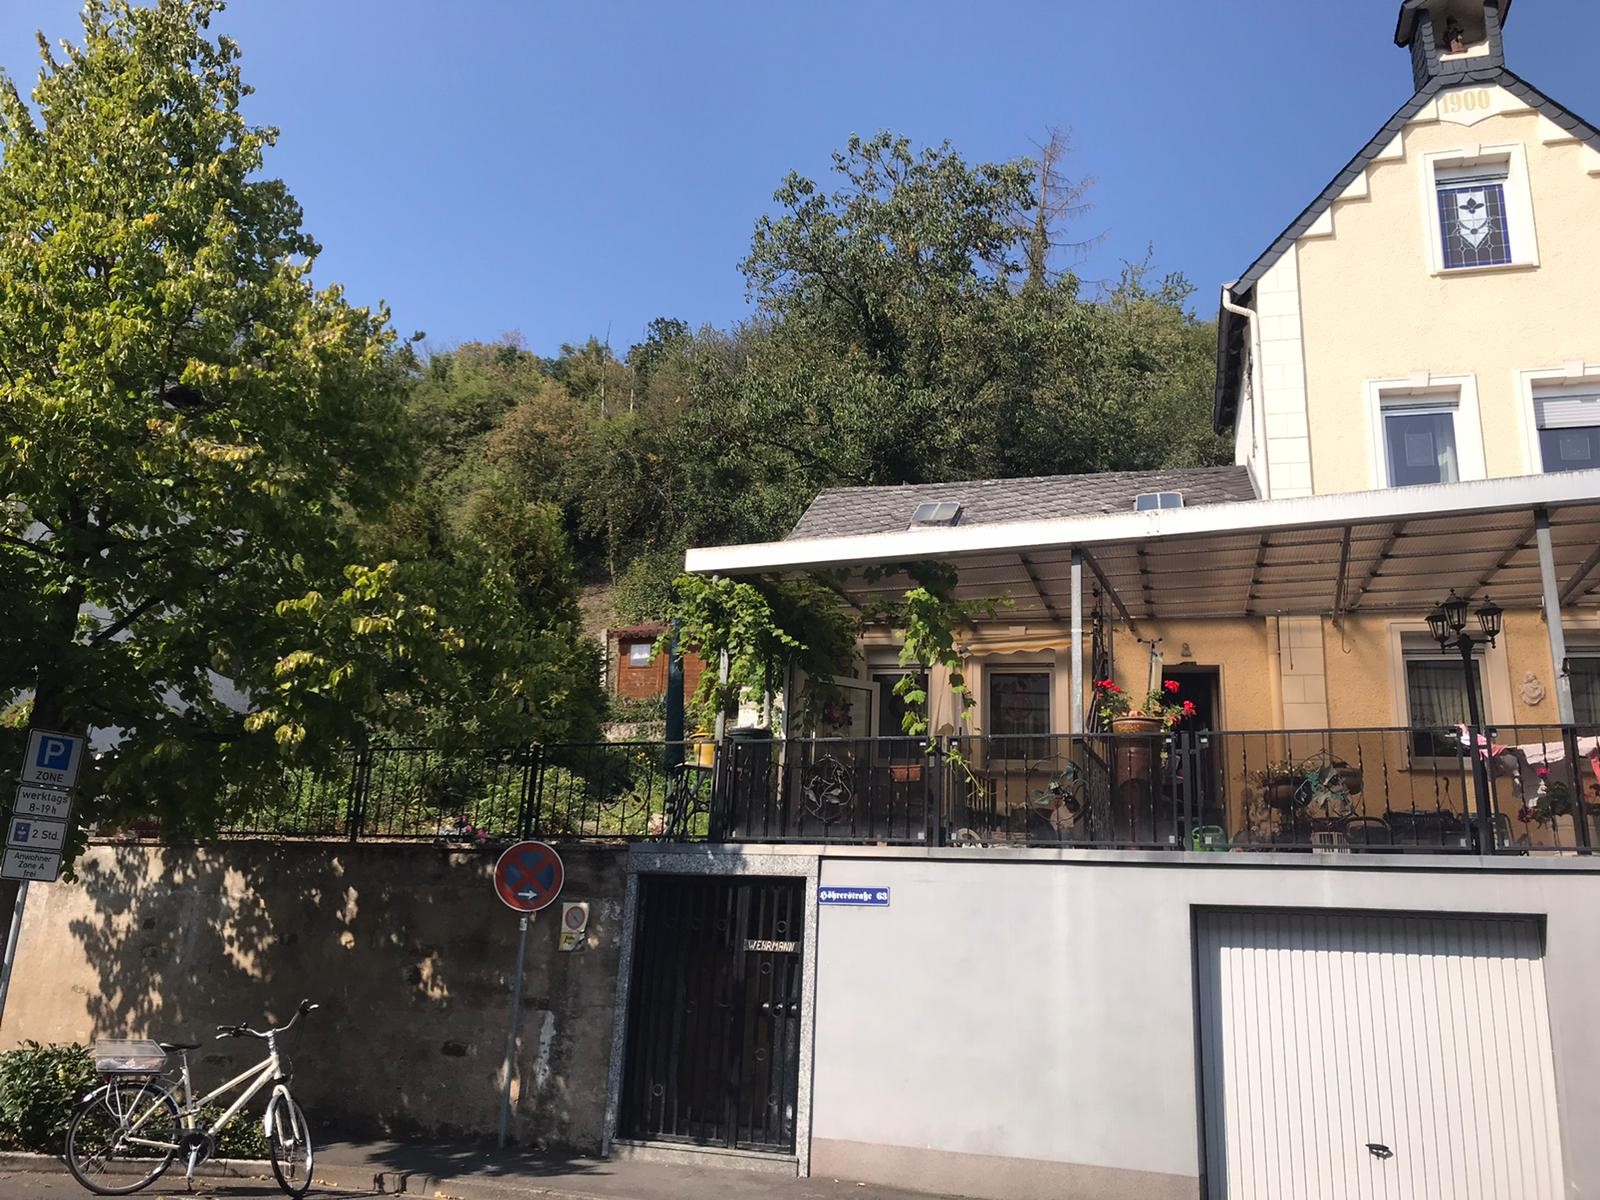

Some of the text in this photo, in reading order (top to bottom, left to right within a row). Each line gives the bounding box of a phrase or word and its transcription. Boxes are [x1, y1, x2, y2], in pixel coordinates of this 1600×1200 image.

[1442, 90, 1491, 113] 1900
[44, 740, 65, 765] P
[35, 770, 64, 783] ZONE
[22, 791, 68, 805] werktags
[32, 829, 59, 841] 2 Std.
[14, 851, 52, 862] Anwohner
[18, 860, 37, 870] Zone
[23, 869, 37, 878] frei
[876, 891, 888, 901] 63
[747, 940, 796, 952] WEHRMANN
